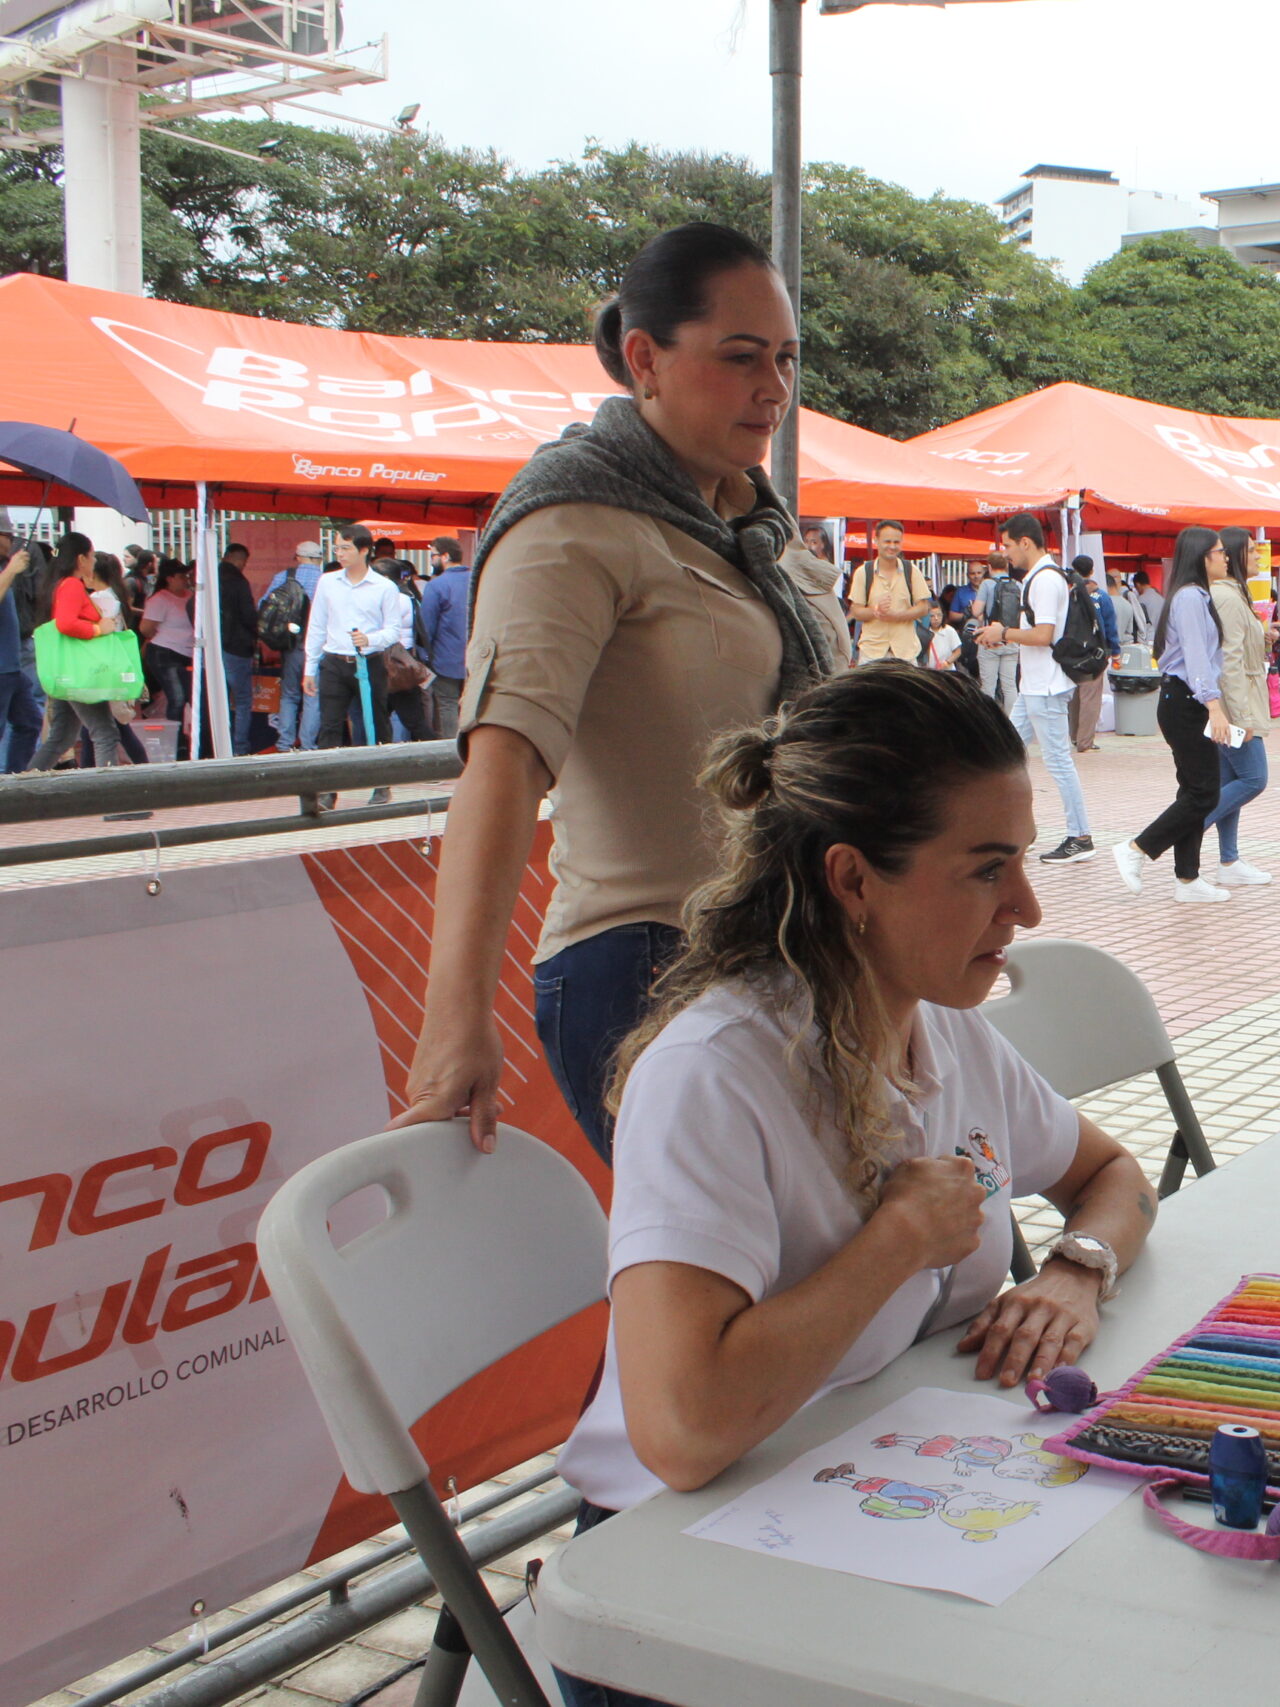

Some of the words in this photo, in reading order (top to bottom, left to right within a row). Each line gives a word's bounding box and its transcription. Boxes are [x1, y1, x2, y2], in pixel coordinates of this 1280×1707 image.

[293, 455, 363, 479] Banco
[369, 463, 447, 484] Popular
[977, 500, 1019, 517] Banco
[7, 1369, 169, 1445] DESARROLLO
[176, 1326, 286, 1381] COMUNAL
